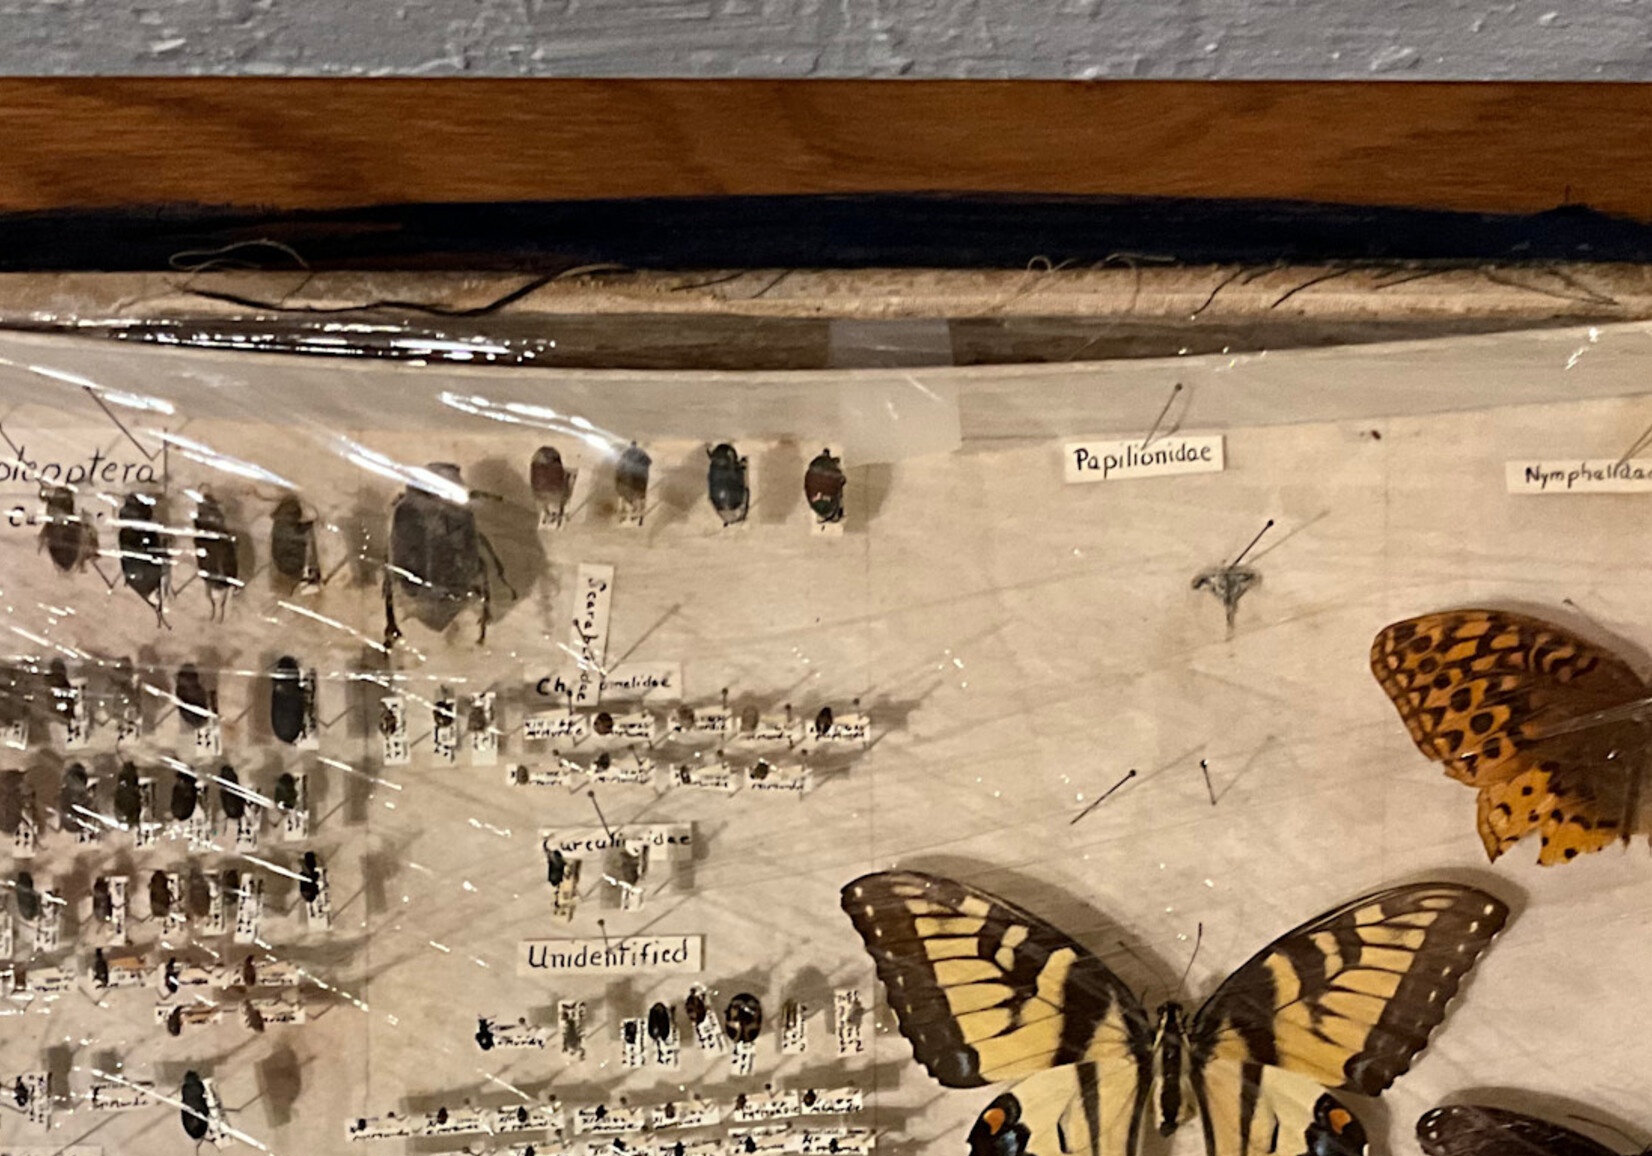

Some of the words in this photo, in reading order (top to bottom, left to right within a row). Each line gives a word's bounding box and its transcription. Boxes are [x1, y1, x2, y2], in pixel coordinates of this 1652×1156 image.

[1073, 442, 1212, 480] Papilionidae
[576, 577, 607, 702] Scarabdae
[528, 939, 688, 969] Unidentified
